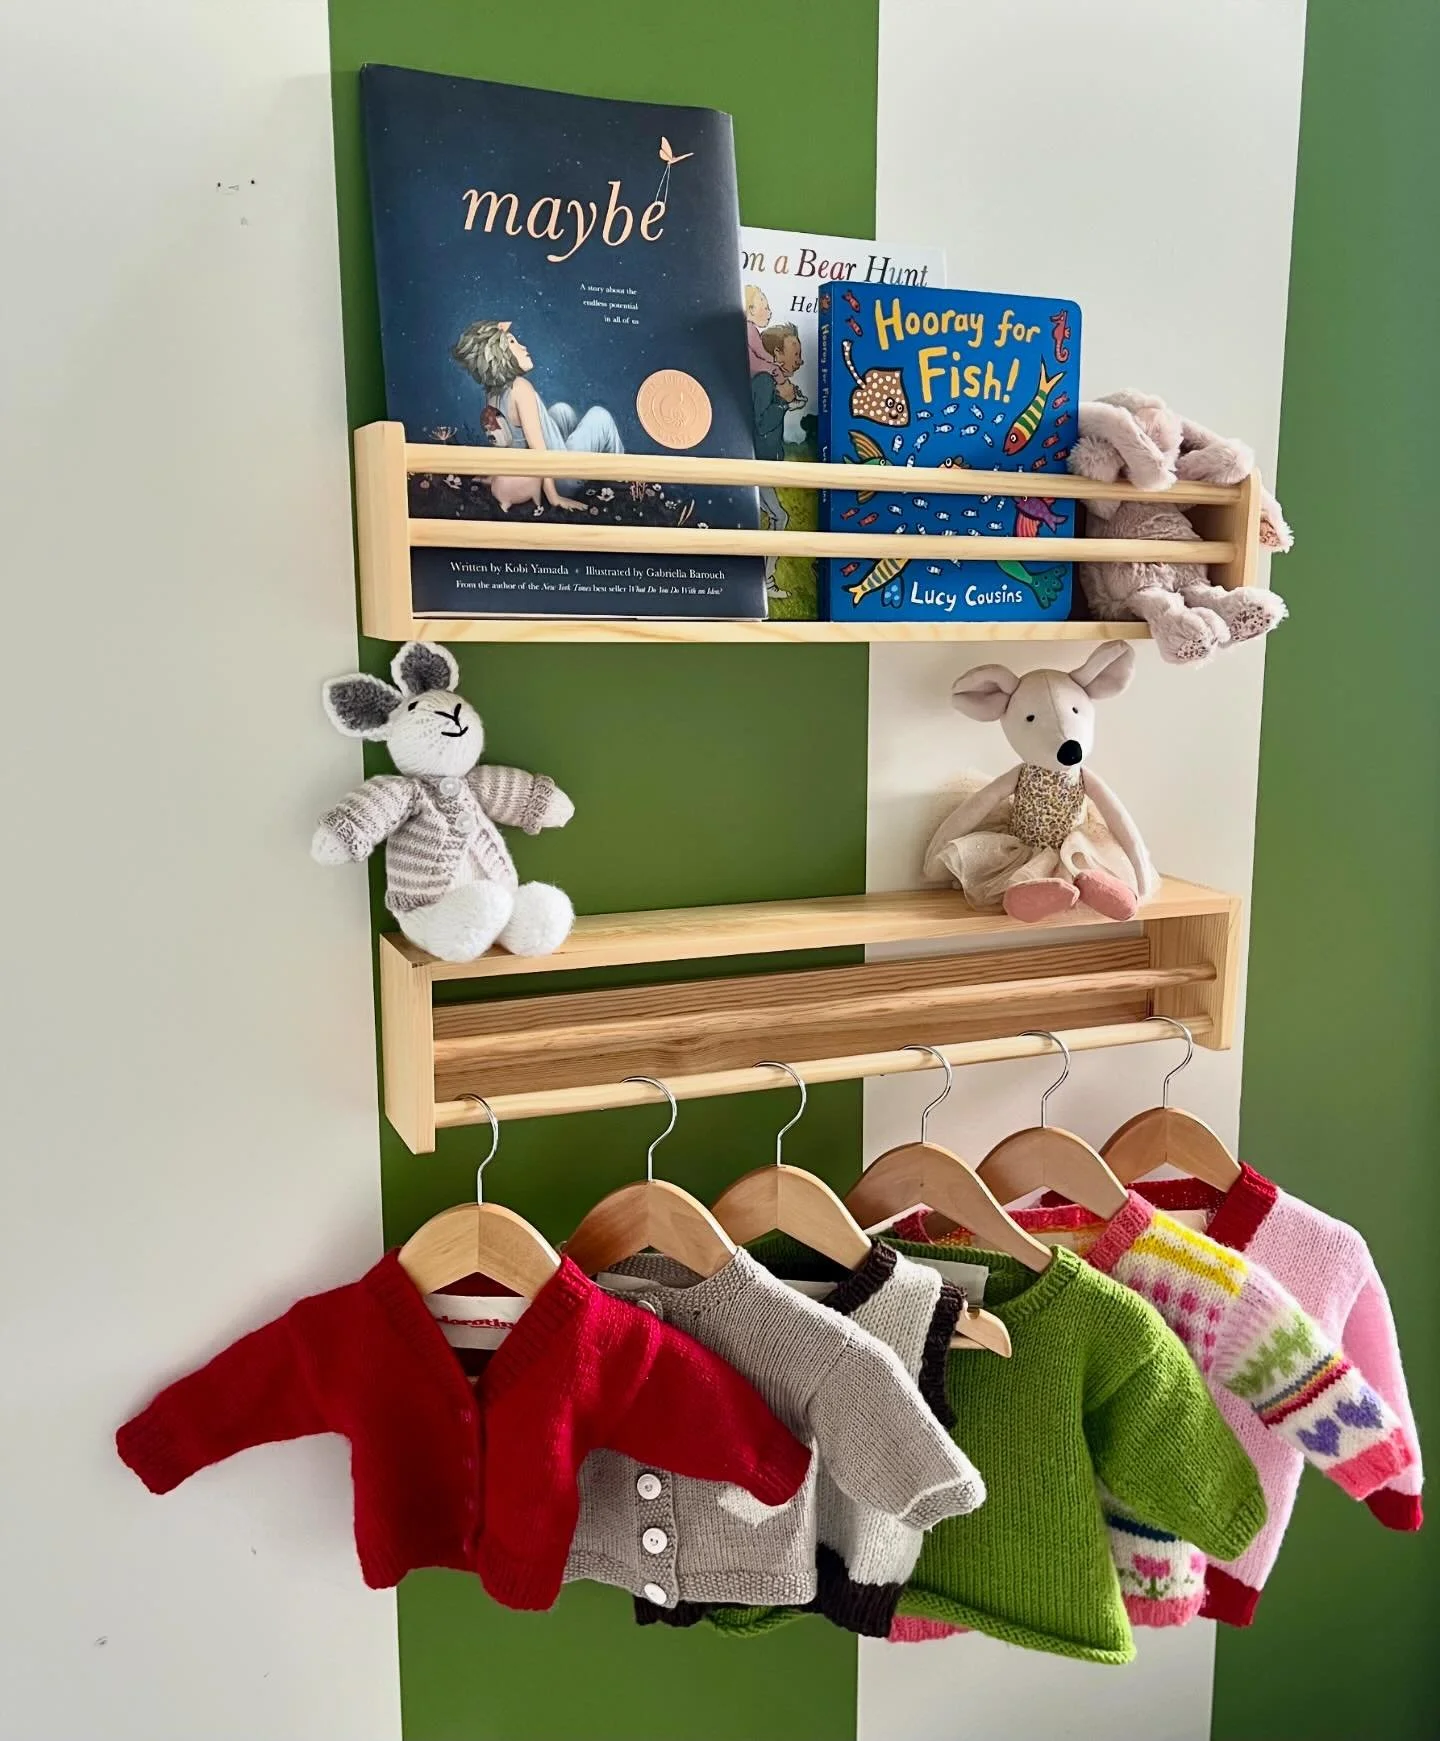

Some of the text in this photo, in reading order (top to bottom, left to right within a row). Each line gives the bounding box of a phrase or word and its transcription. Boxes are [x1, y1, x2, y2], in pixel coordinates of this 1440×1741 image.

[462, 180, 666, 263] maybe
[773, 255, 790, 275] a
[795, 248, 857, 281] Bear
[864, 254, 928, 288] Hunt
[605, 286, 625, 294] about
[583, 299, 607, 307] endless
[603, 314, 611, 322] in
[875, 298, 1041, 350] Hooray for
[918, 346, 1020, 403] Fish!
[450, 561, 725, 580] Written by Kobi Yamada Illustrated by Gabriella Barouch
[456, 580, 476, 589] From
[477, 580, 489, 589] the
[491, 581, 516, 590] author
[517, 582, 526, 590] of
[527, 582, 540, 591] the
[541, 582, 555, 591] New
[572, 584, 592, 592] Times
[608, 585, 626, 593] seller
[681, 587, 696, 595] With
[911, 581, 1023, 612] Lucy Cousins
